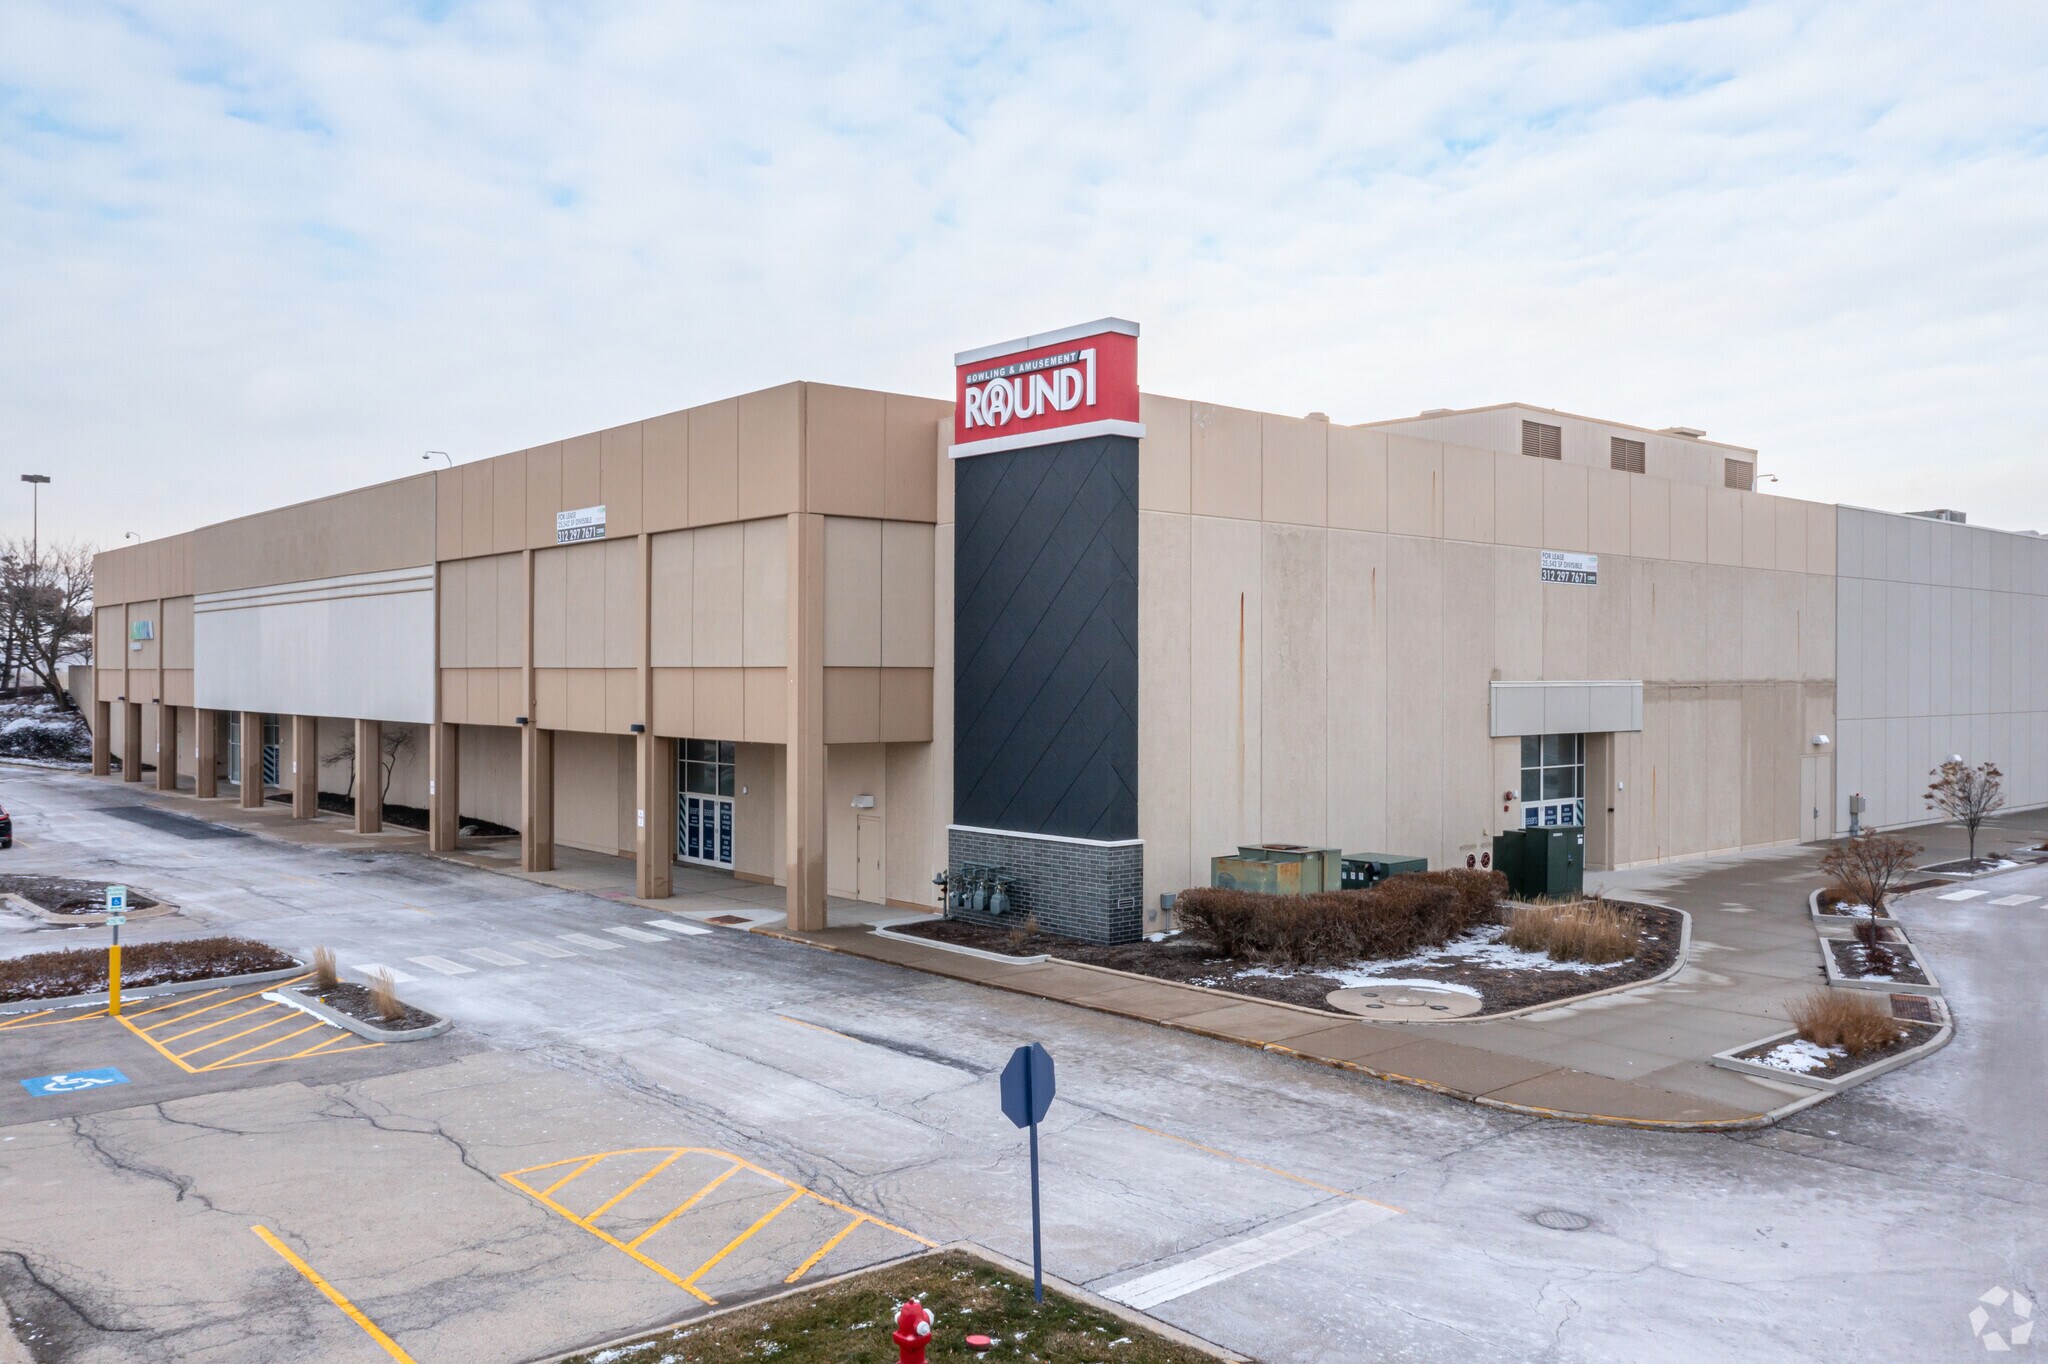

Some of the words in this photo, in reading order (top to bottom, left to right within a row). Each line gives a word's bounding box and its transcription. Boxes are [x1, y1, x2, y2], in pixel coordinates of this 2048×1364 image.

[966, 367, 1006, 383] BOWLING
[1009, 366, 1015, 374] &
[1019, 352, 1077, 372] AMUSEMENT
[558, 530, 568, 542] 312
[570, 529, 580, 540] 297
[582, 526, 596, 539] 7671
[1542, 569, 1555, 581] 312
[1557, 570, 1570, 582] 297
[1571, 572, 1587, 583] 7671
